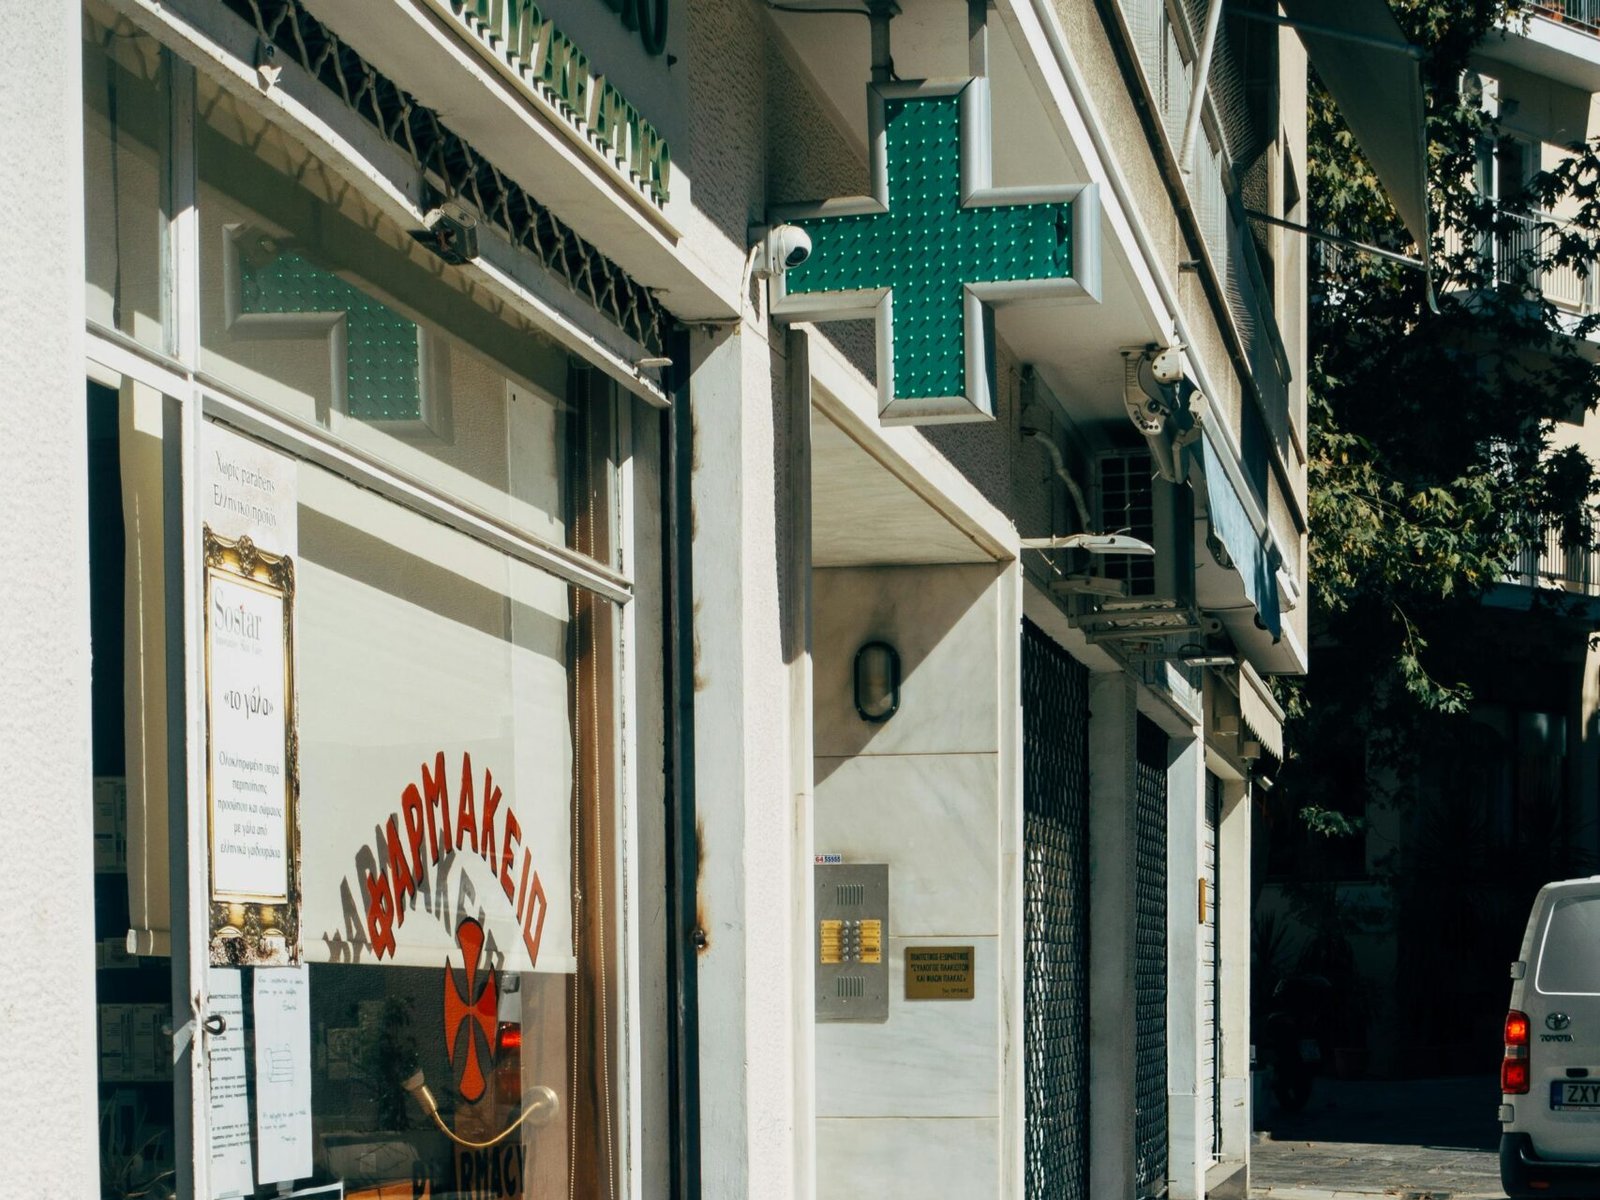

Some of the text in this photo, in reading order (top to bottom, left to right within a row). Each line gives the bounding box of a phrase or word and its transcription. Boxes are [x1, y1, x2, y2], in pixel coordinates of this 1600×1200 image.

[215, 450, 276, 493] Χωρίς parabens
[213, 484, 250, 517] Ελληνικό
[214, 585, 262, 641] Sostar
[366, 751, 547, 968] ΦΑΡΜΑΚΕΙΟ
[1540, 1034, 1575, 1043] TOYOTA
